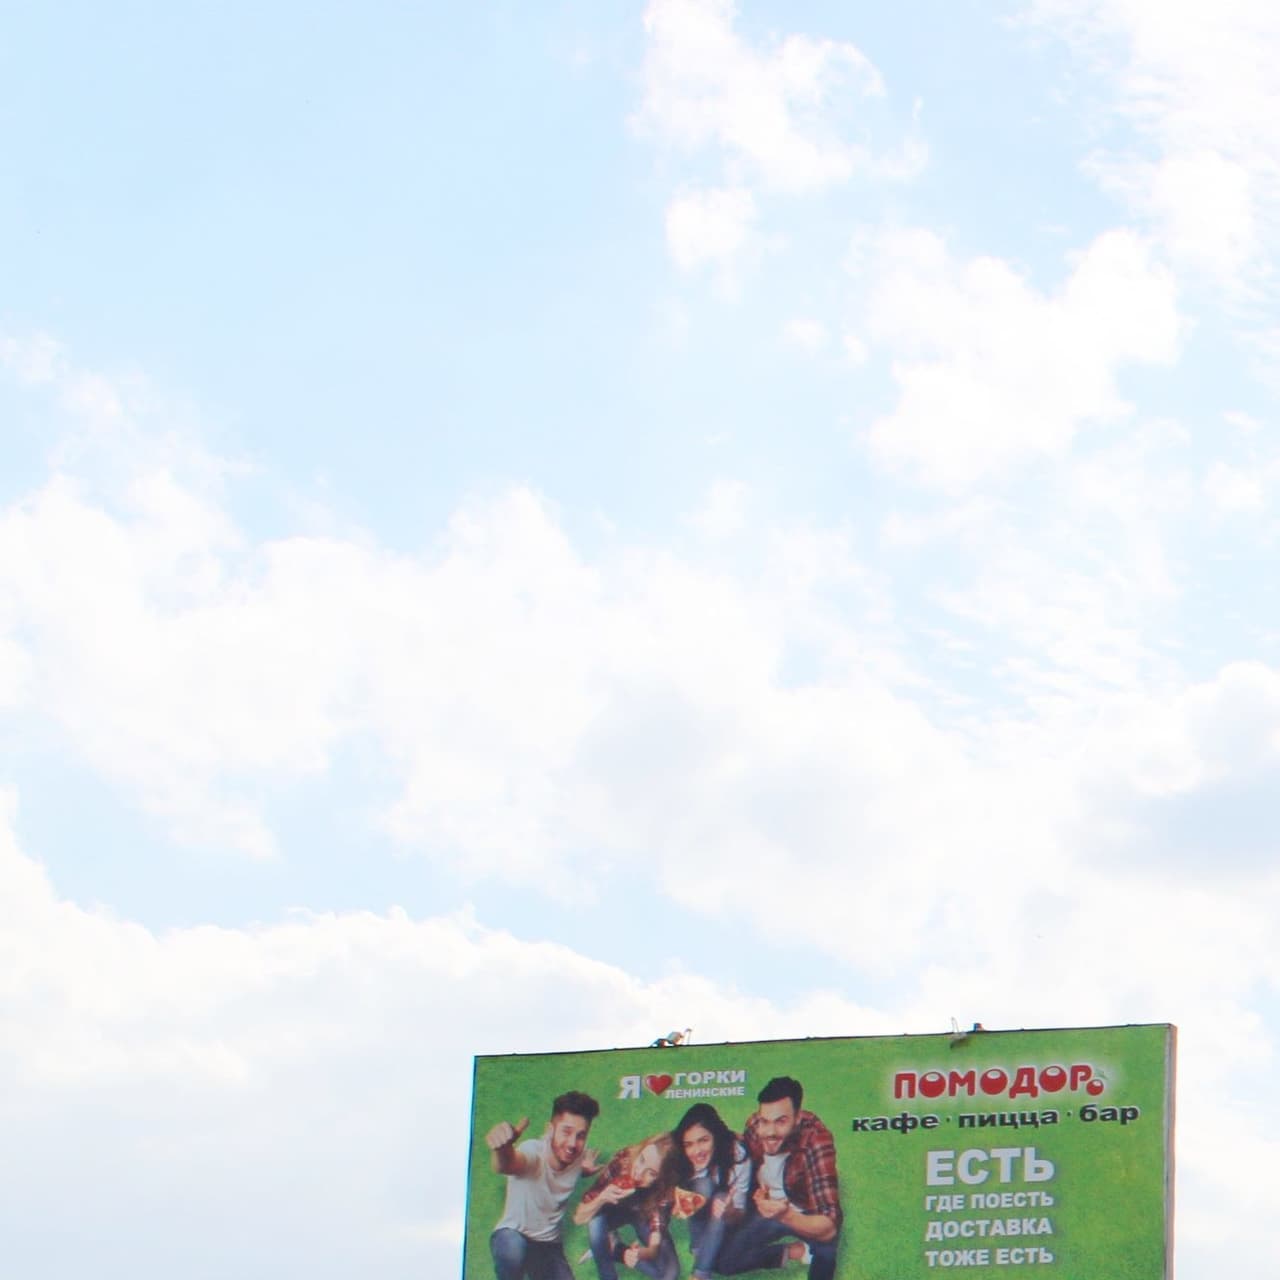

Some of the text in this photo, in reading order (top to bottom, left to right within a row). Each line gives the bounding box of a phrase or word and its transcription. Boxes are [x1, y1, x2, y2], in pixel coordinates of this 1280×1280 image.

[618, 1070, 746, 1100] Я ГОРКИ
[665, 1086, 745, 1099] ЛЕНИНСКИЕ
[852, 1103, 1139, 1133] кафе пицца бар
[926, 1147, 1055, 1186] ЕСТЬ
[925, 1191, 1054, 1212] ГДЕ ПОЕСТЬ
[925, 1218, 1053, 1242] ДОСТАВКА
[925, 1248, 1054, 1267] ТОЖЕ ЕСТЬ
